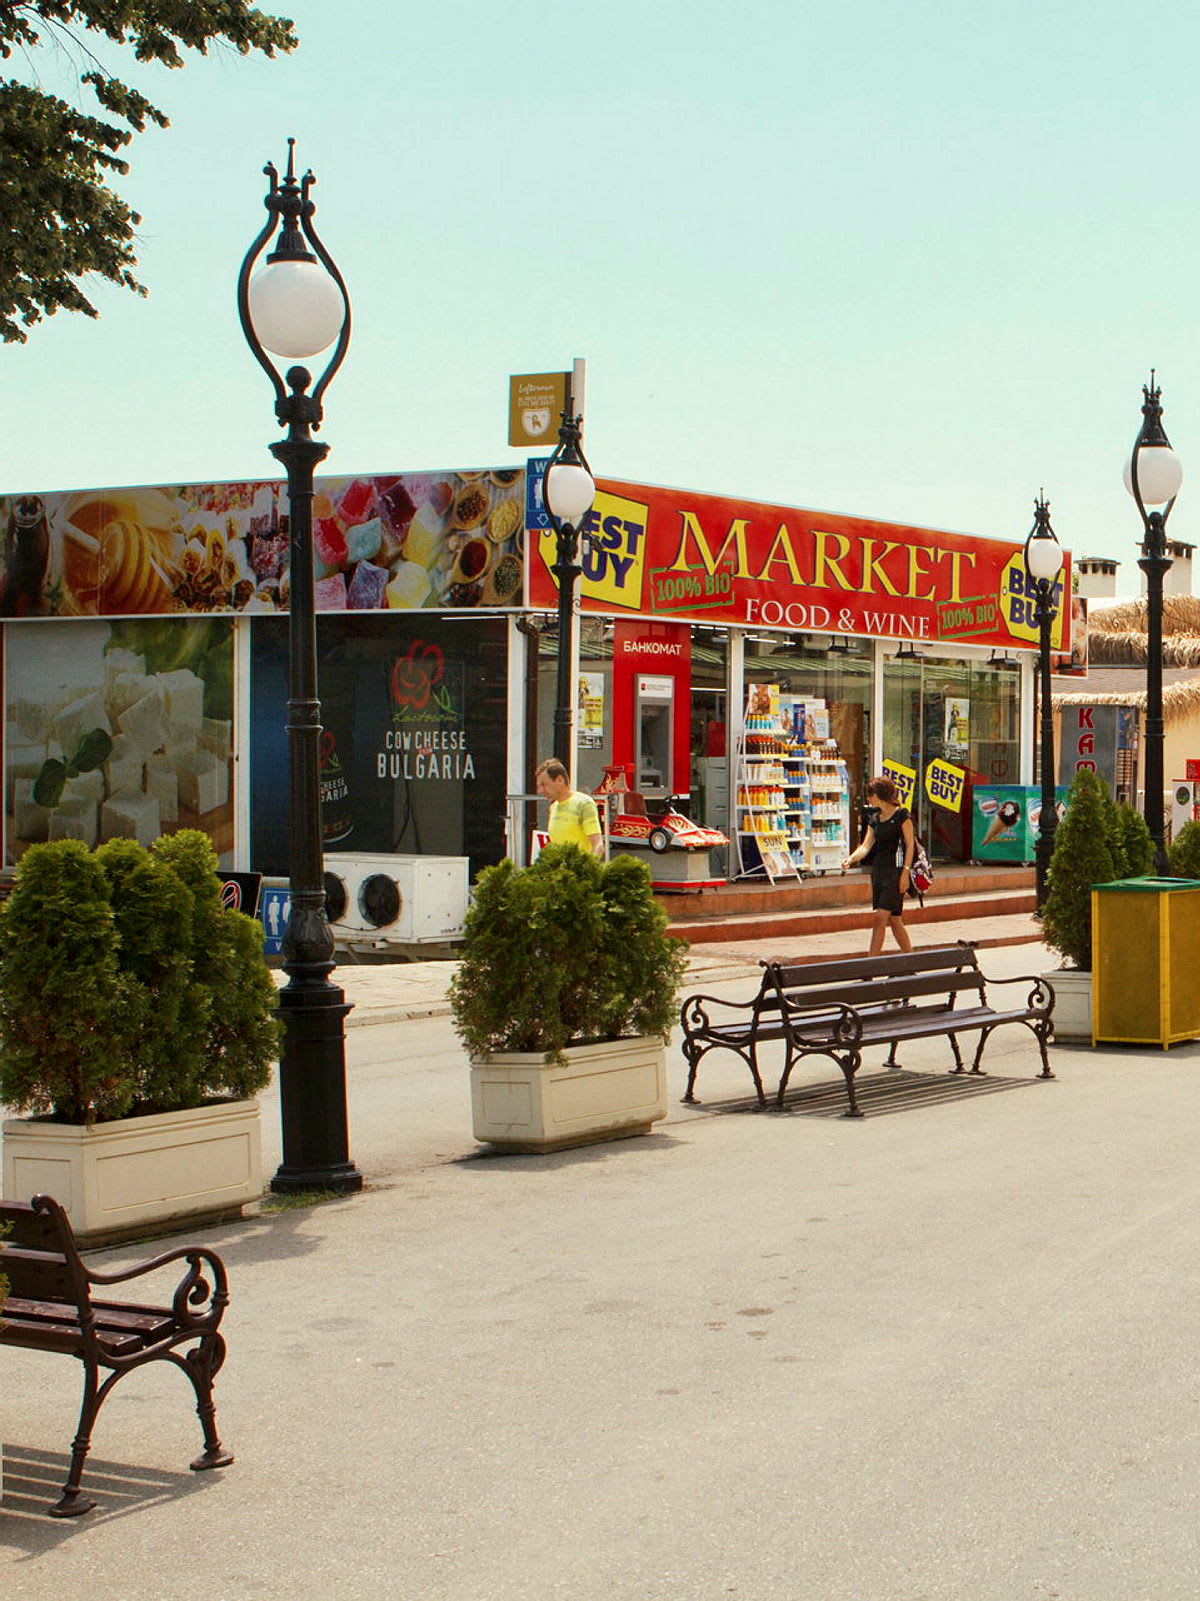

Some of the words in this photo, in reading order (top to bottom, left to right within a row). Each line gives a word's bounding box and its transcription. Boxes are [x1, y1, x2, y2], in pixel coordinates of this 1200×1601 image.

[582, 509, 644, 556] EST
[582, 549, 635, 589] UY
[666, 510, 977, 604] MARKET
[656, 576, 701, 601] 100%
[704, 572, 730, 596] BIO
[1009, 566, 1064, 608] BET
[744, 597, 830, 629] FOOD
[837, 607, 856, 631] &
[864, 610, 930, 639] WINE
[941, 604, 974, 630] 100%
[975, 603, 996, 623] BIO
[1009, 596, 1058, 630] BU
[623, 640, 683, 656] БАНКОМАТ
[386, 731, 412, 750] COW
[415, 731, 467, 750] CHEESE
[377, 752, 476, 780] BULGARIA
[931, 764, 963, 791] BEST
[930, 781, 959, 804] BUY
